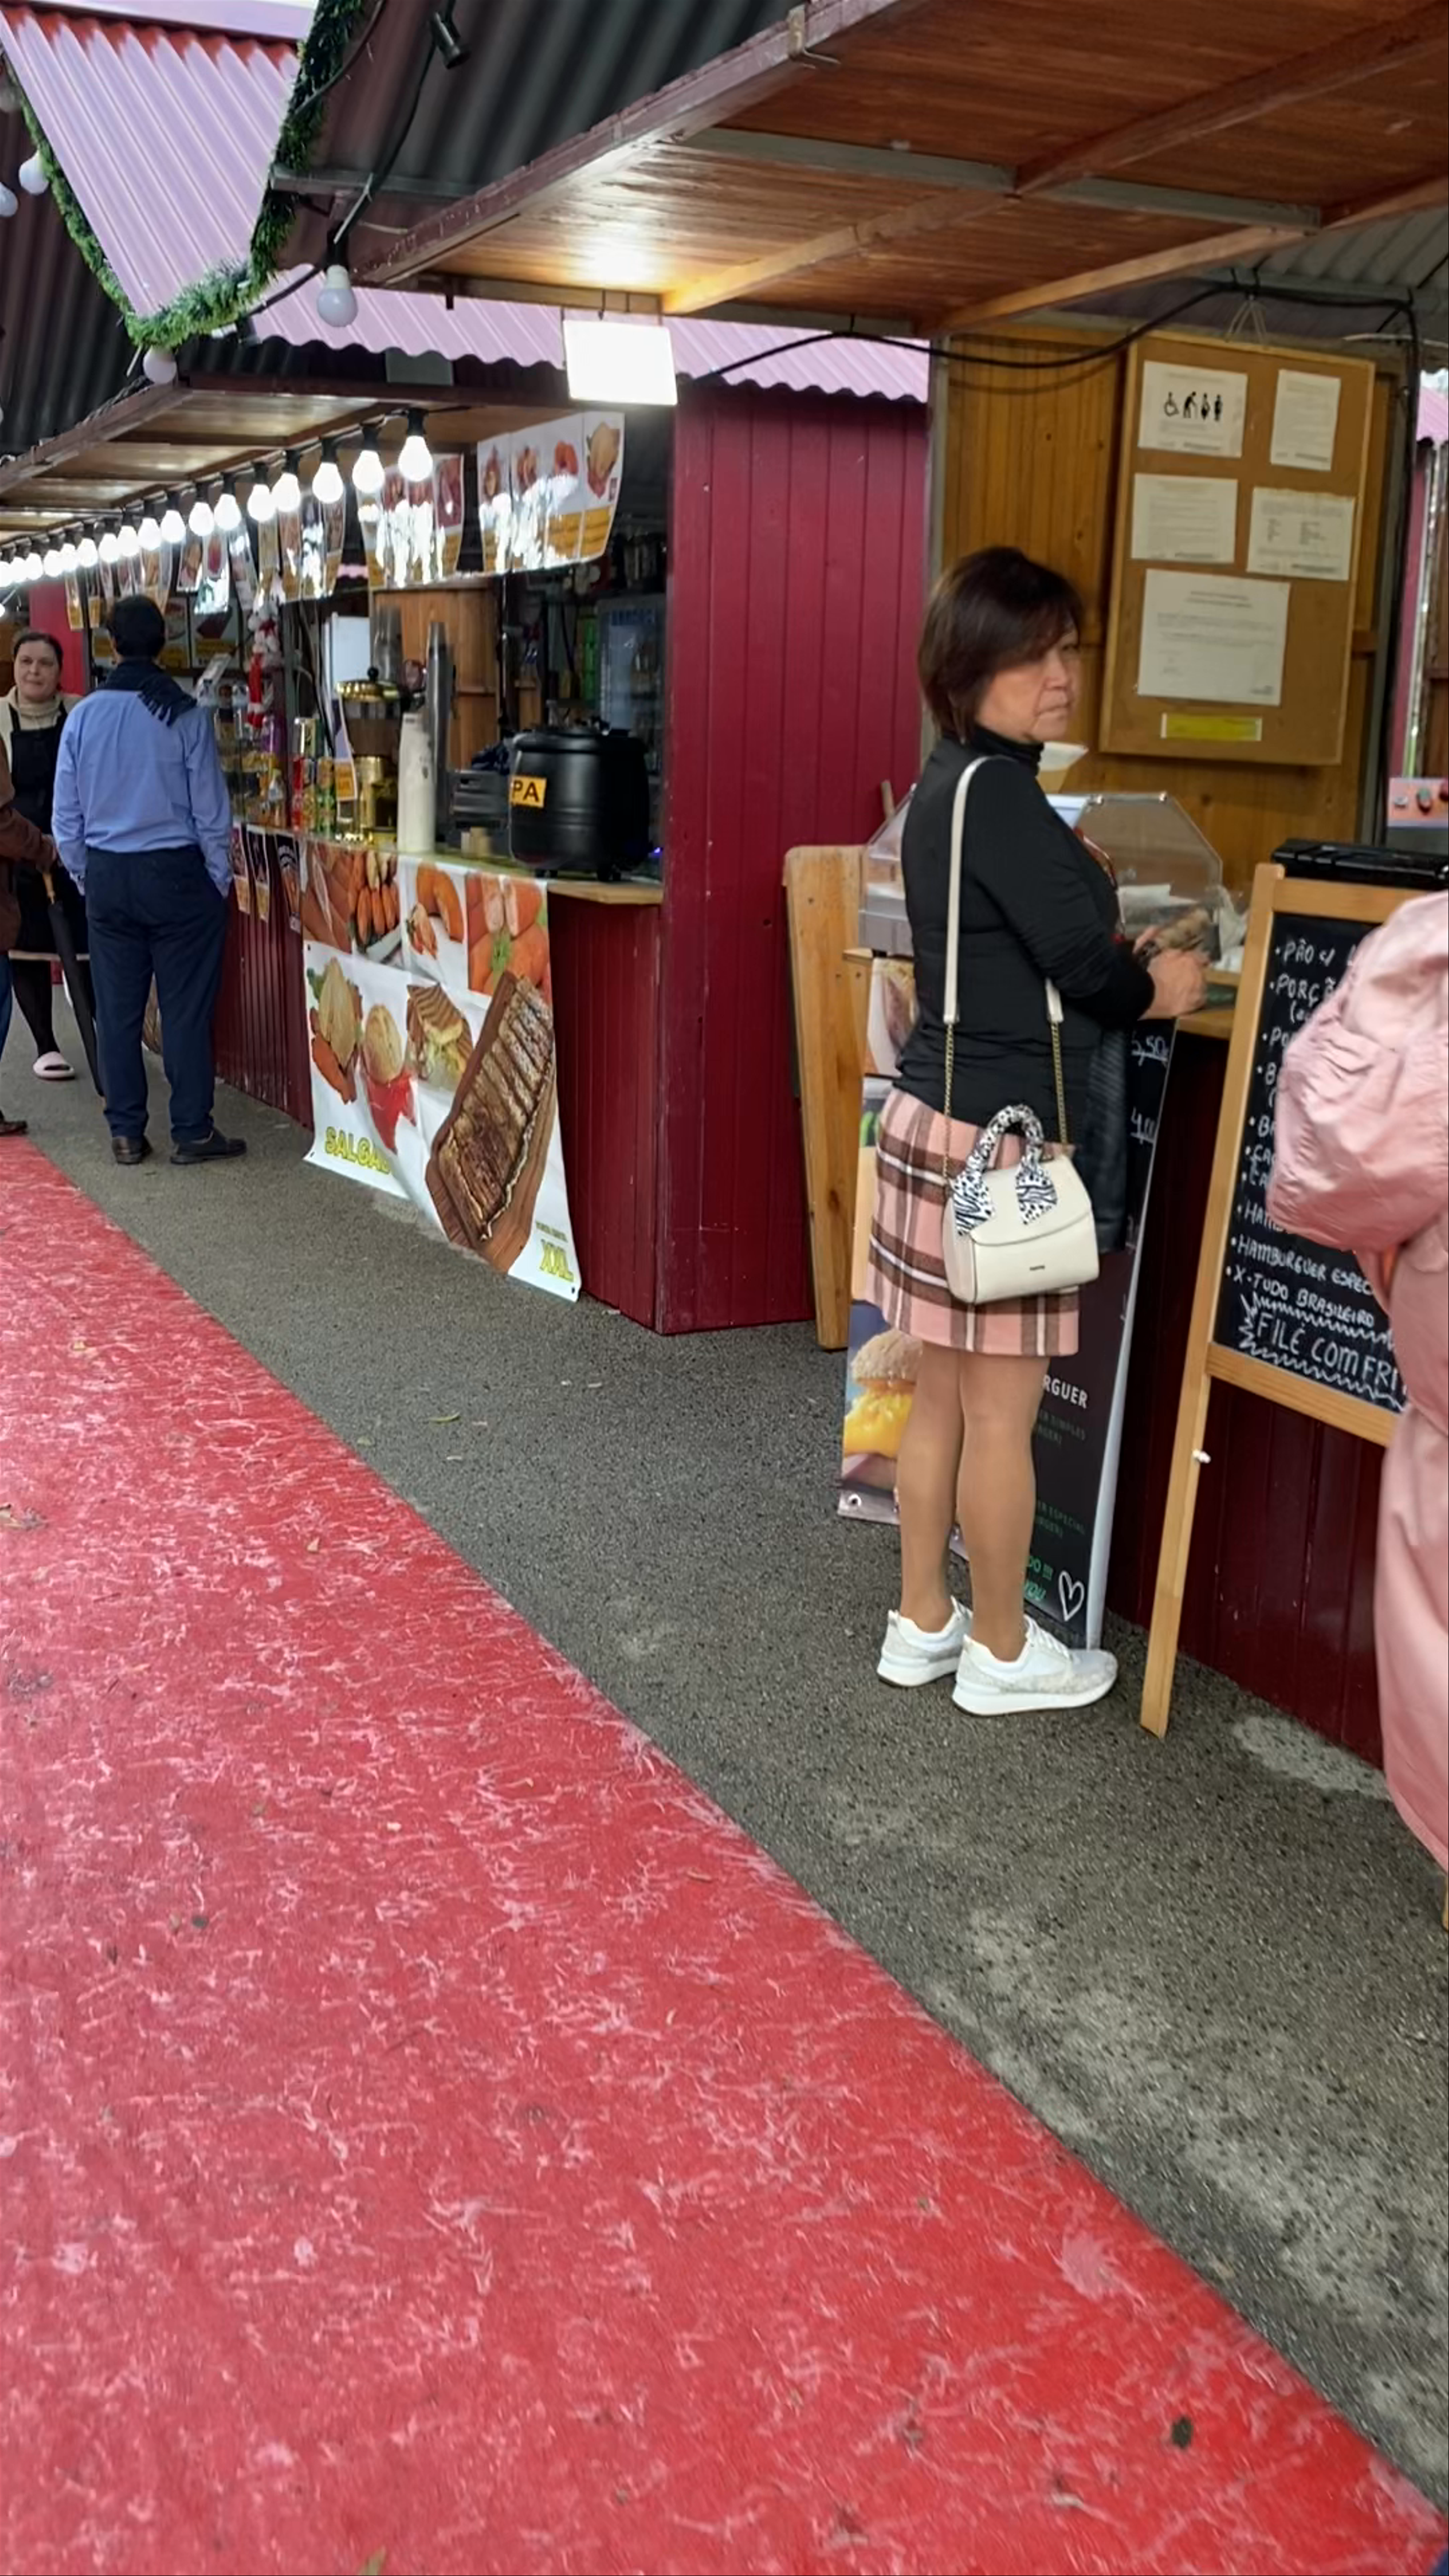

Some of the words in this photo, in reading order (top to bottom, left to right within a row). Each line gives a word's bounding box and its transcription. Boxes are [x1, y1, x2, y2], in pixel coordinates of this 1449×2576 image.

[1237, 1233, 1326, 1281] HAMBURGUER
[1295, 1288, 1374, 1328] BRASILEIRO
[1311, 1337, 1359, 1375] COM
[1361, 1355, 1407, 1395] FRI
